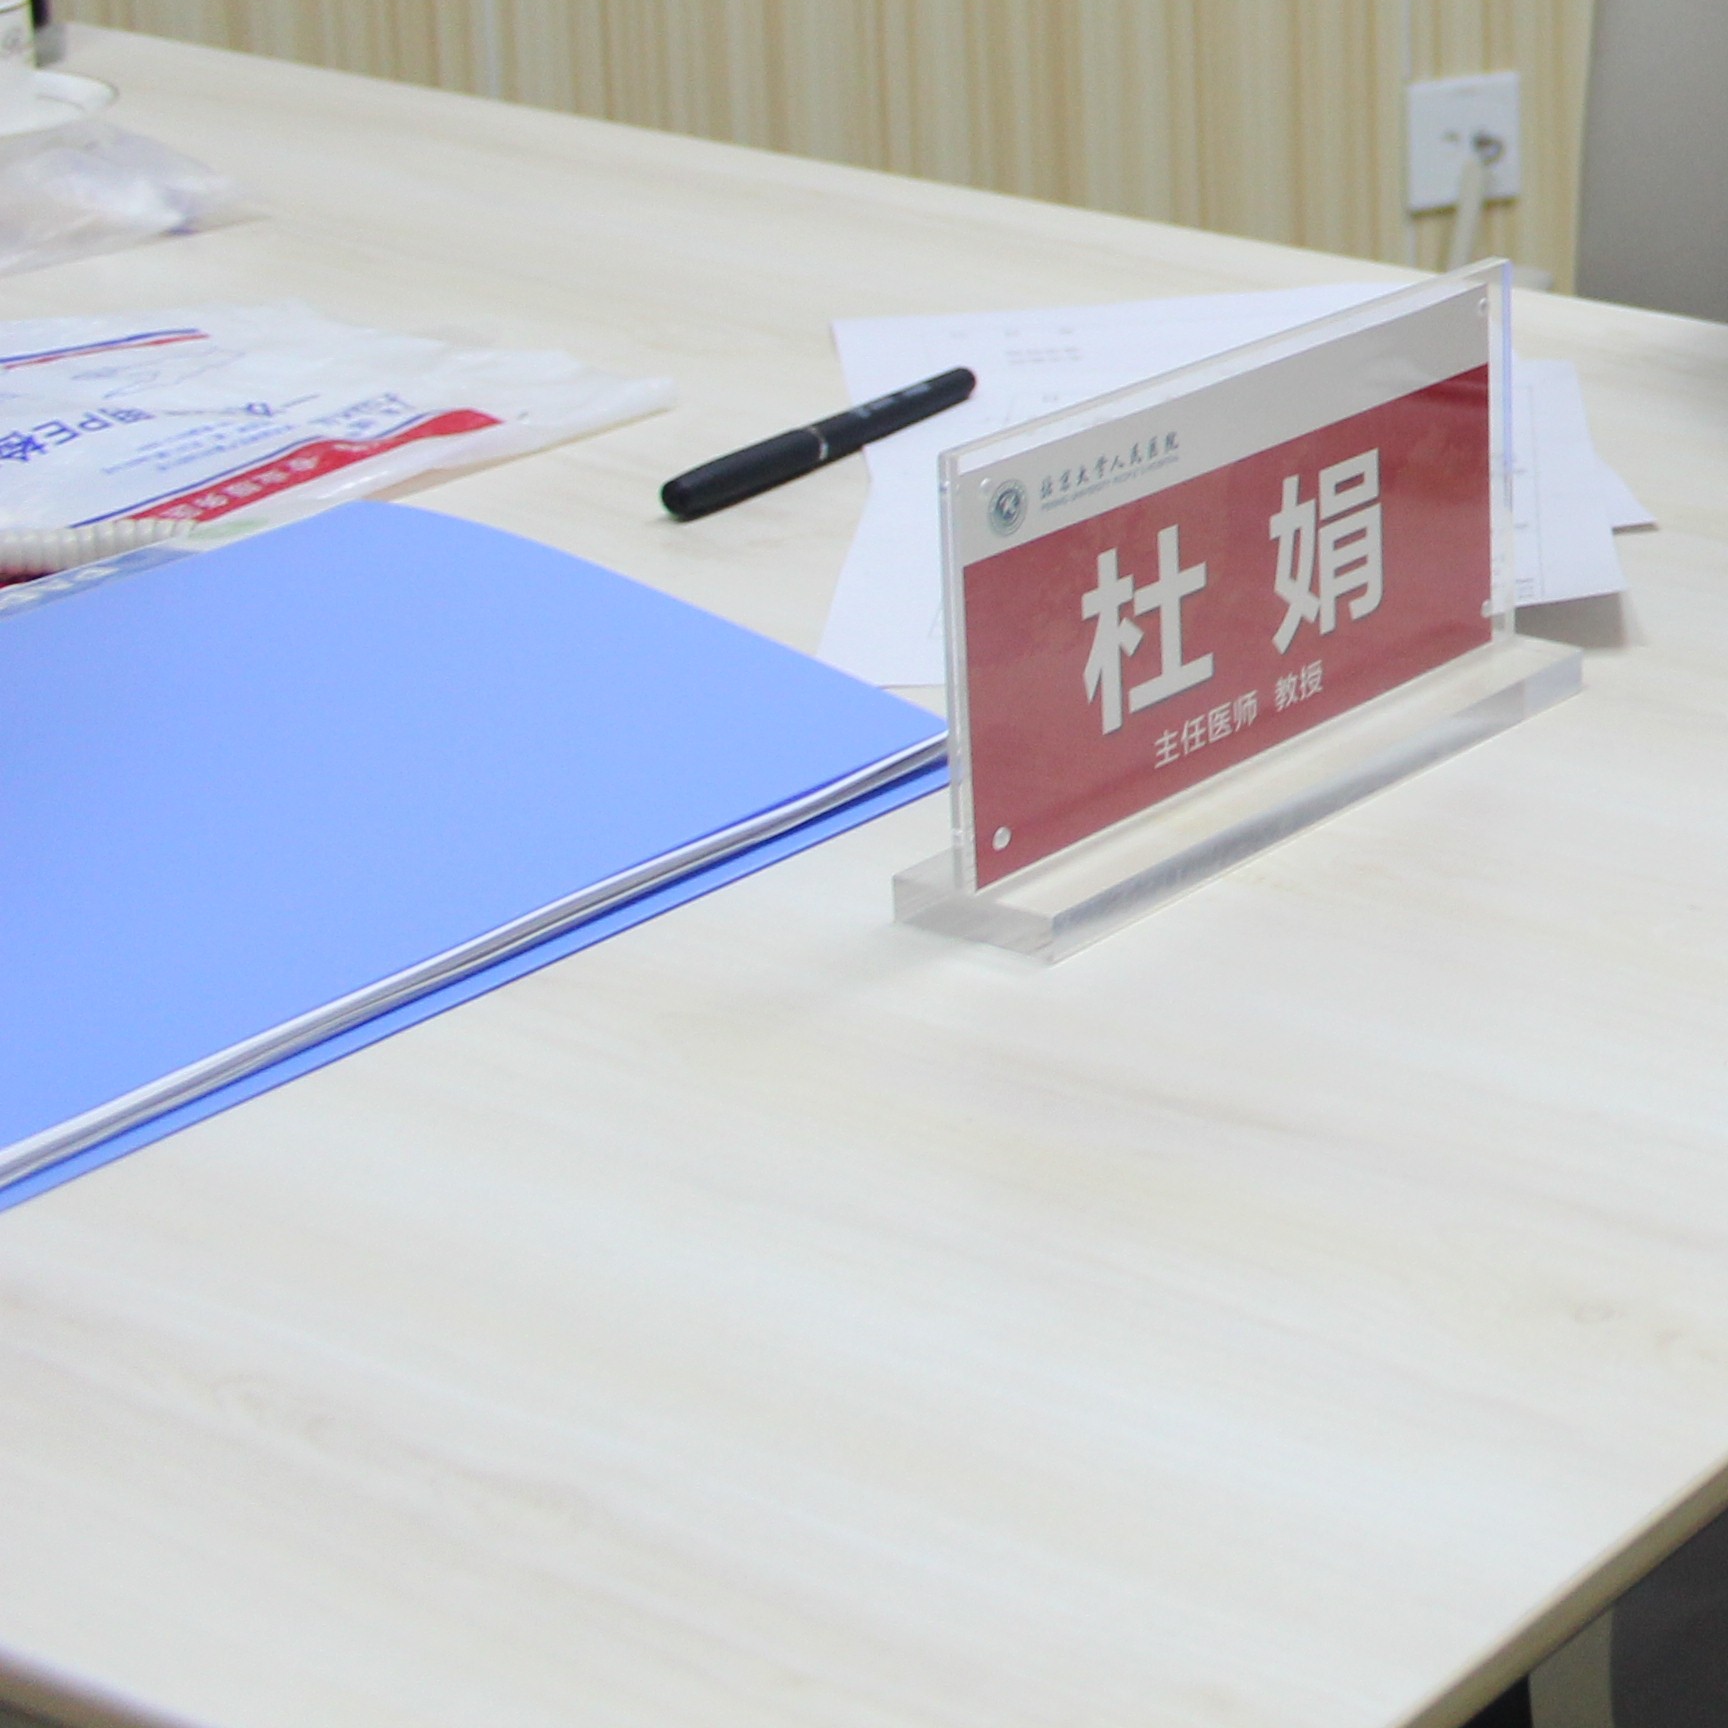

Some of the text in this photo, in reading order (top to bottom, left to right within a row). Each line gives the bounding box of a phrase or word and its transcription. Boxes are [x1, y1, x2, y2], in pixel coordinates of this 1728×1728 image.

[1082, 448, 1383, 736] 杜 娟
[1154, 660, 1324, 769] 主任医师 教授
